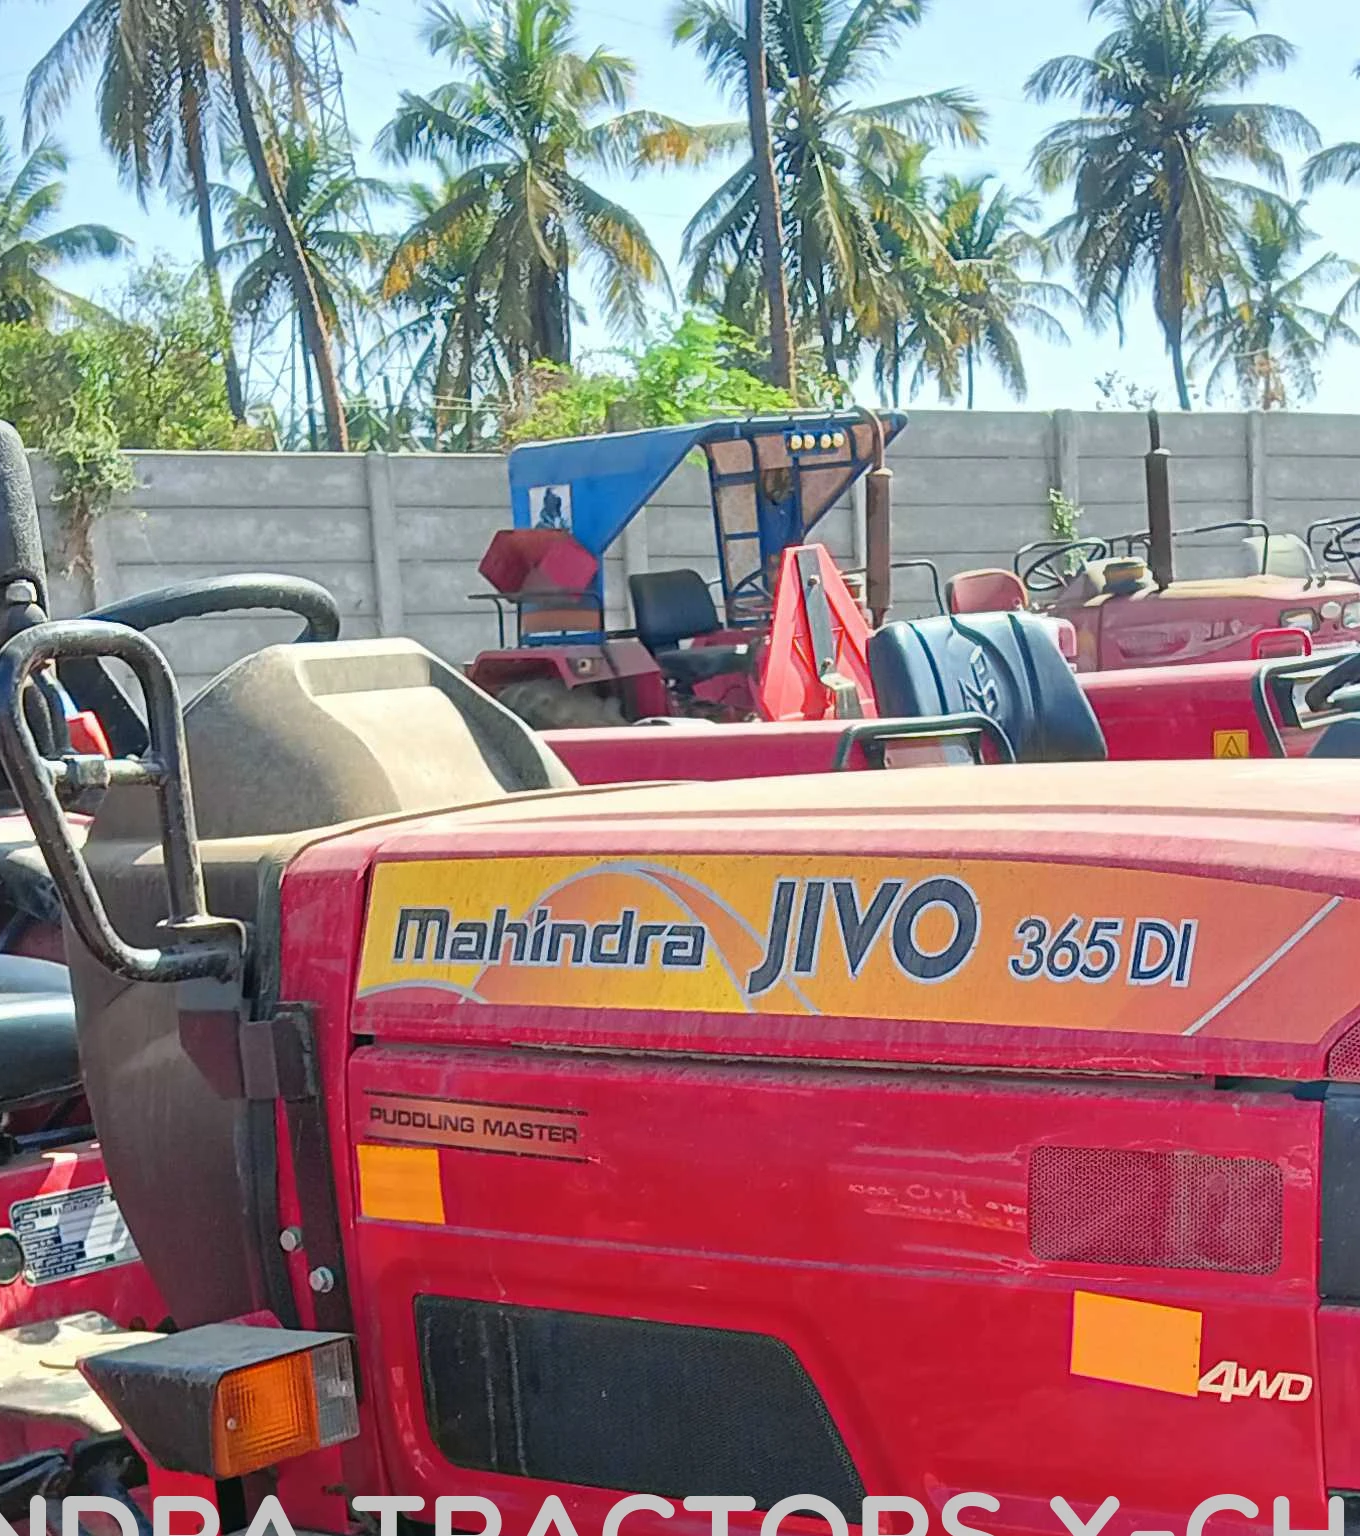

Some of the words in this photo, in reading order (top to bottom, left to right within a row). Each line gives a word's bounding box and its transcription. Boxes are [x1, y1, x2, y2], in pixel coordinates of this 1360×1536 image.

[392, 907, 707, 967] Mahindra
[746, 878, 980, 995] JIVO
[1010, 916, 1124, 980] 365
[1129, 919, 1195, 984] DI
[369, 1106, 475, 1134] PUDDLING
[482, 1118, 579, 1145] MASTER
[1198, 1360, 1313, 1403] 4WD
